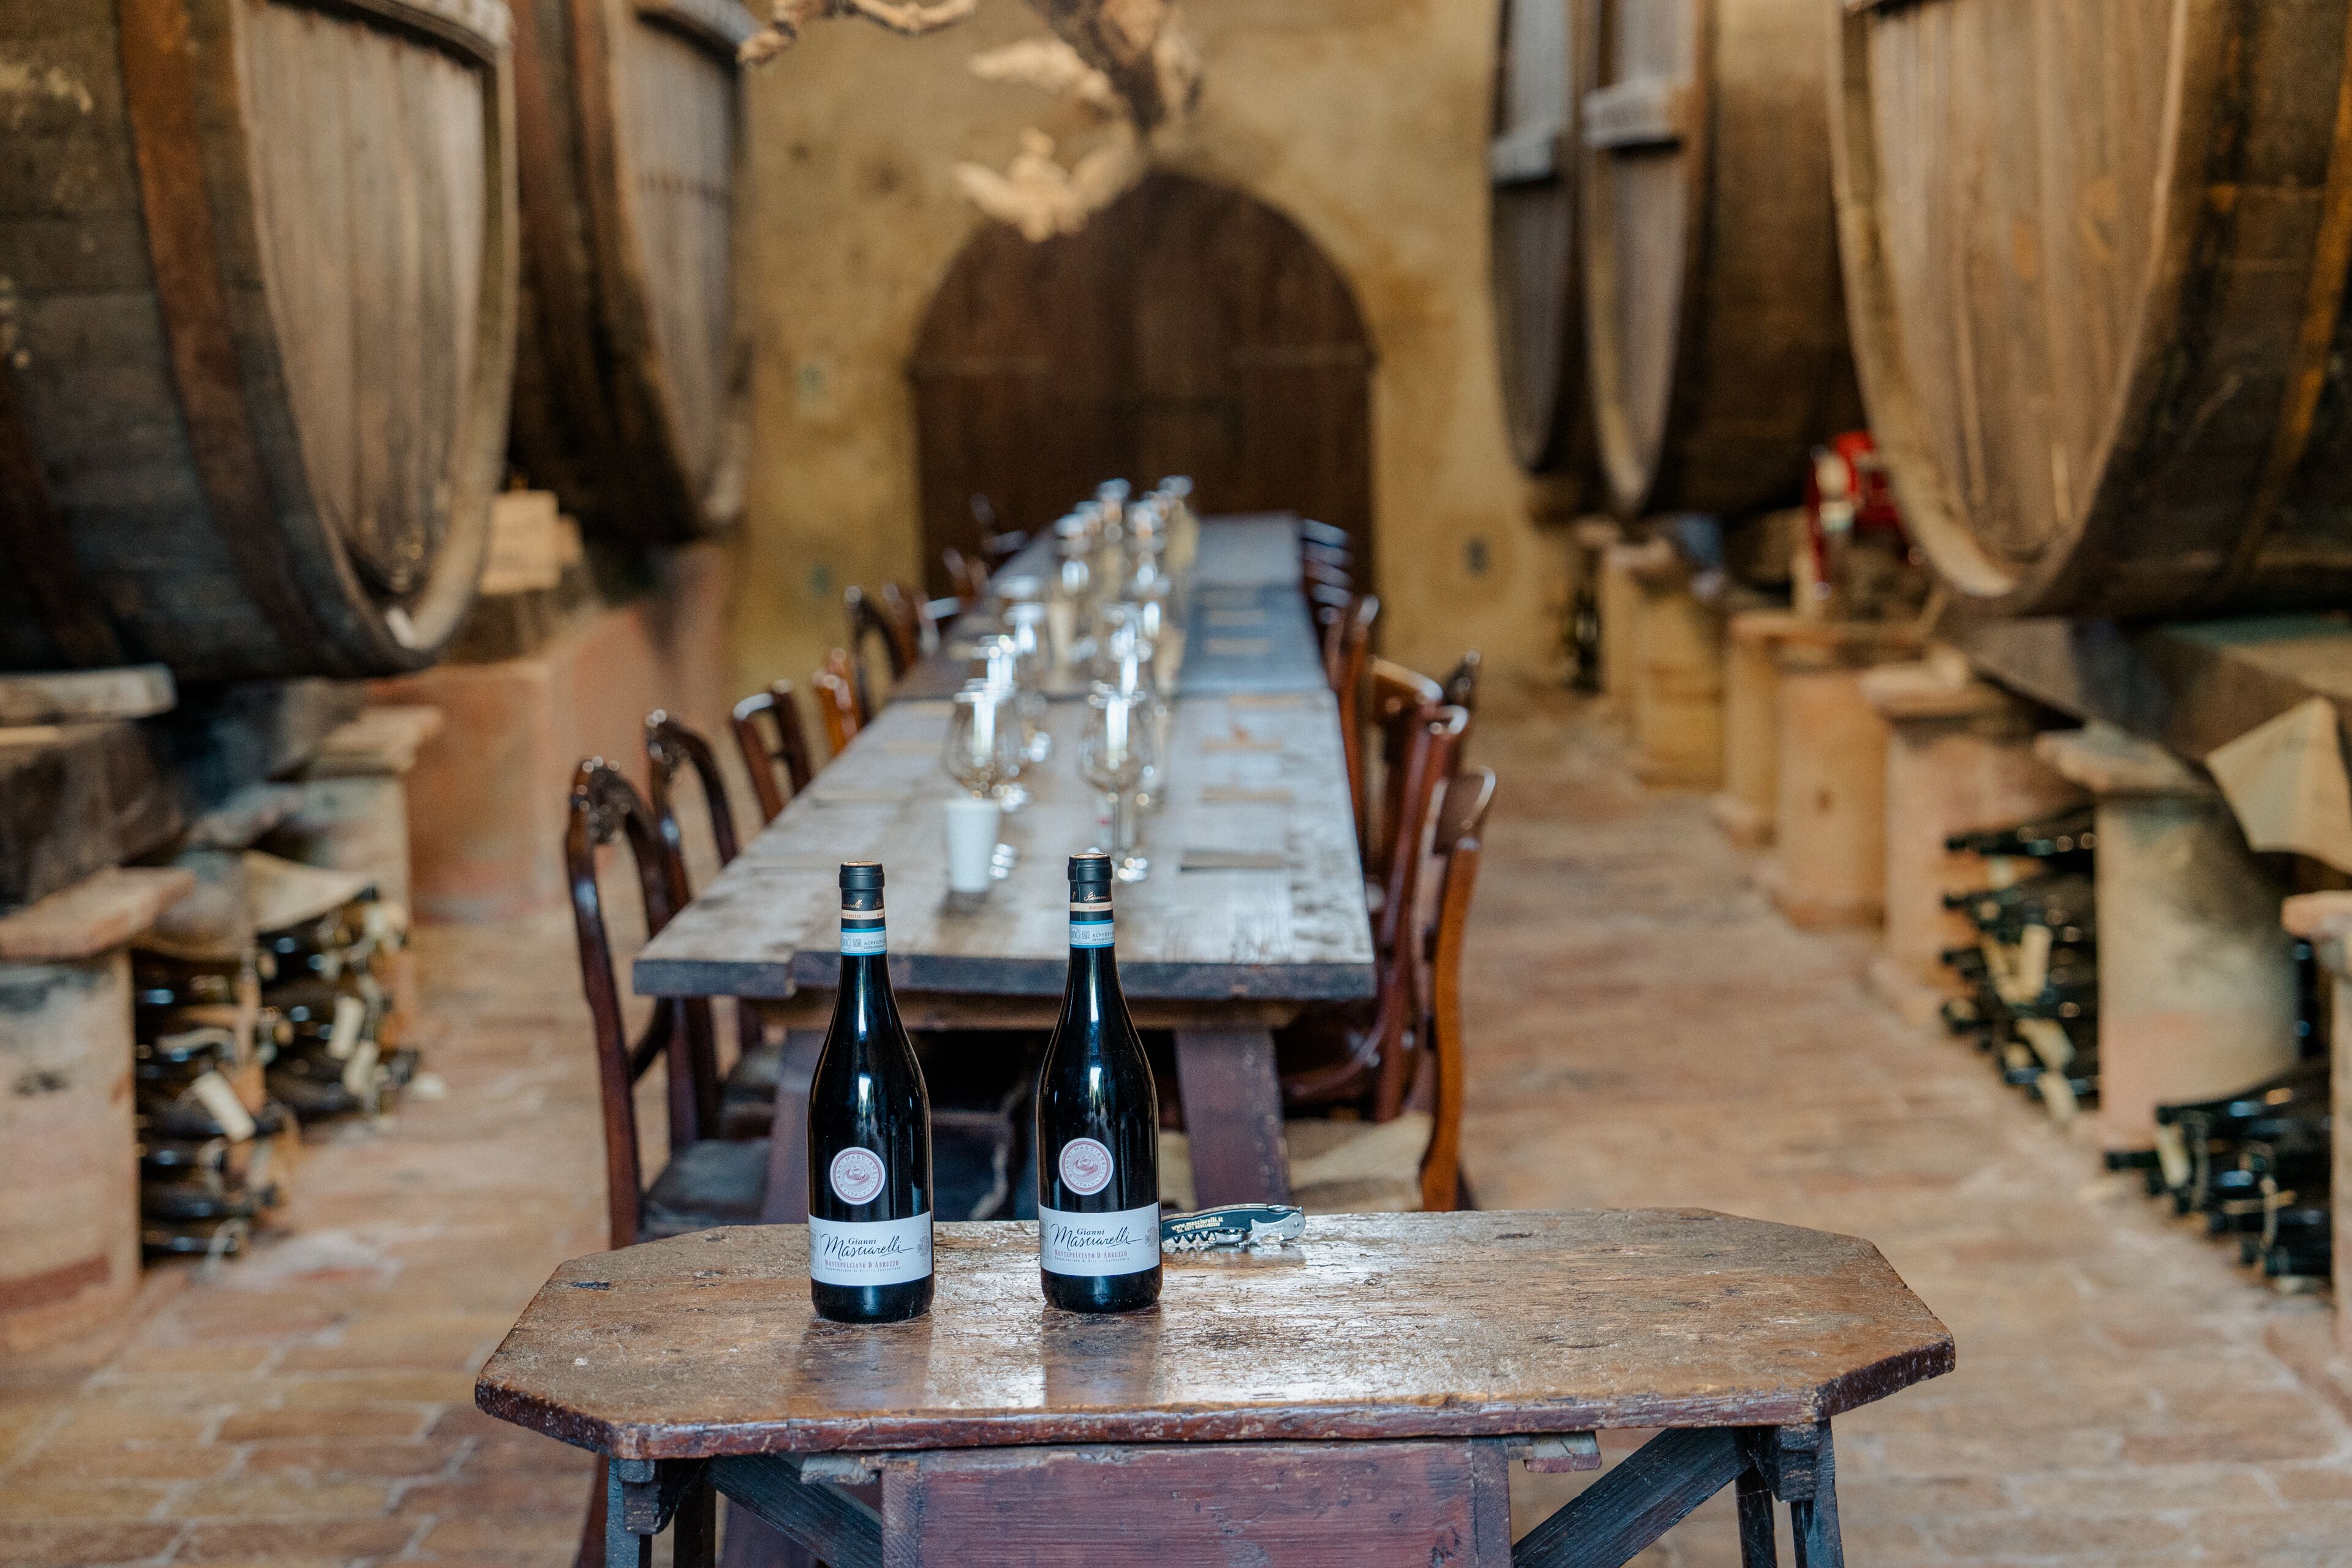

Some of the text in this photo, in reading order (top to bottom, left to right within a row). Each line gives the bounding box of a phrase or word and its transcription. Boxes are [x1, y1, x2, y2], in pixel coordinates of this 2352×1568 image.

[845, 1155, 878, 1188] MASCIARELLI
[1074, 1145, 1106, 1178] MASCIARELLI
[1171, 1216, 1224, 1231] www.masciarelli.it
